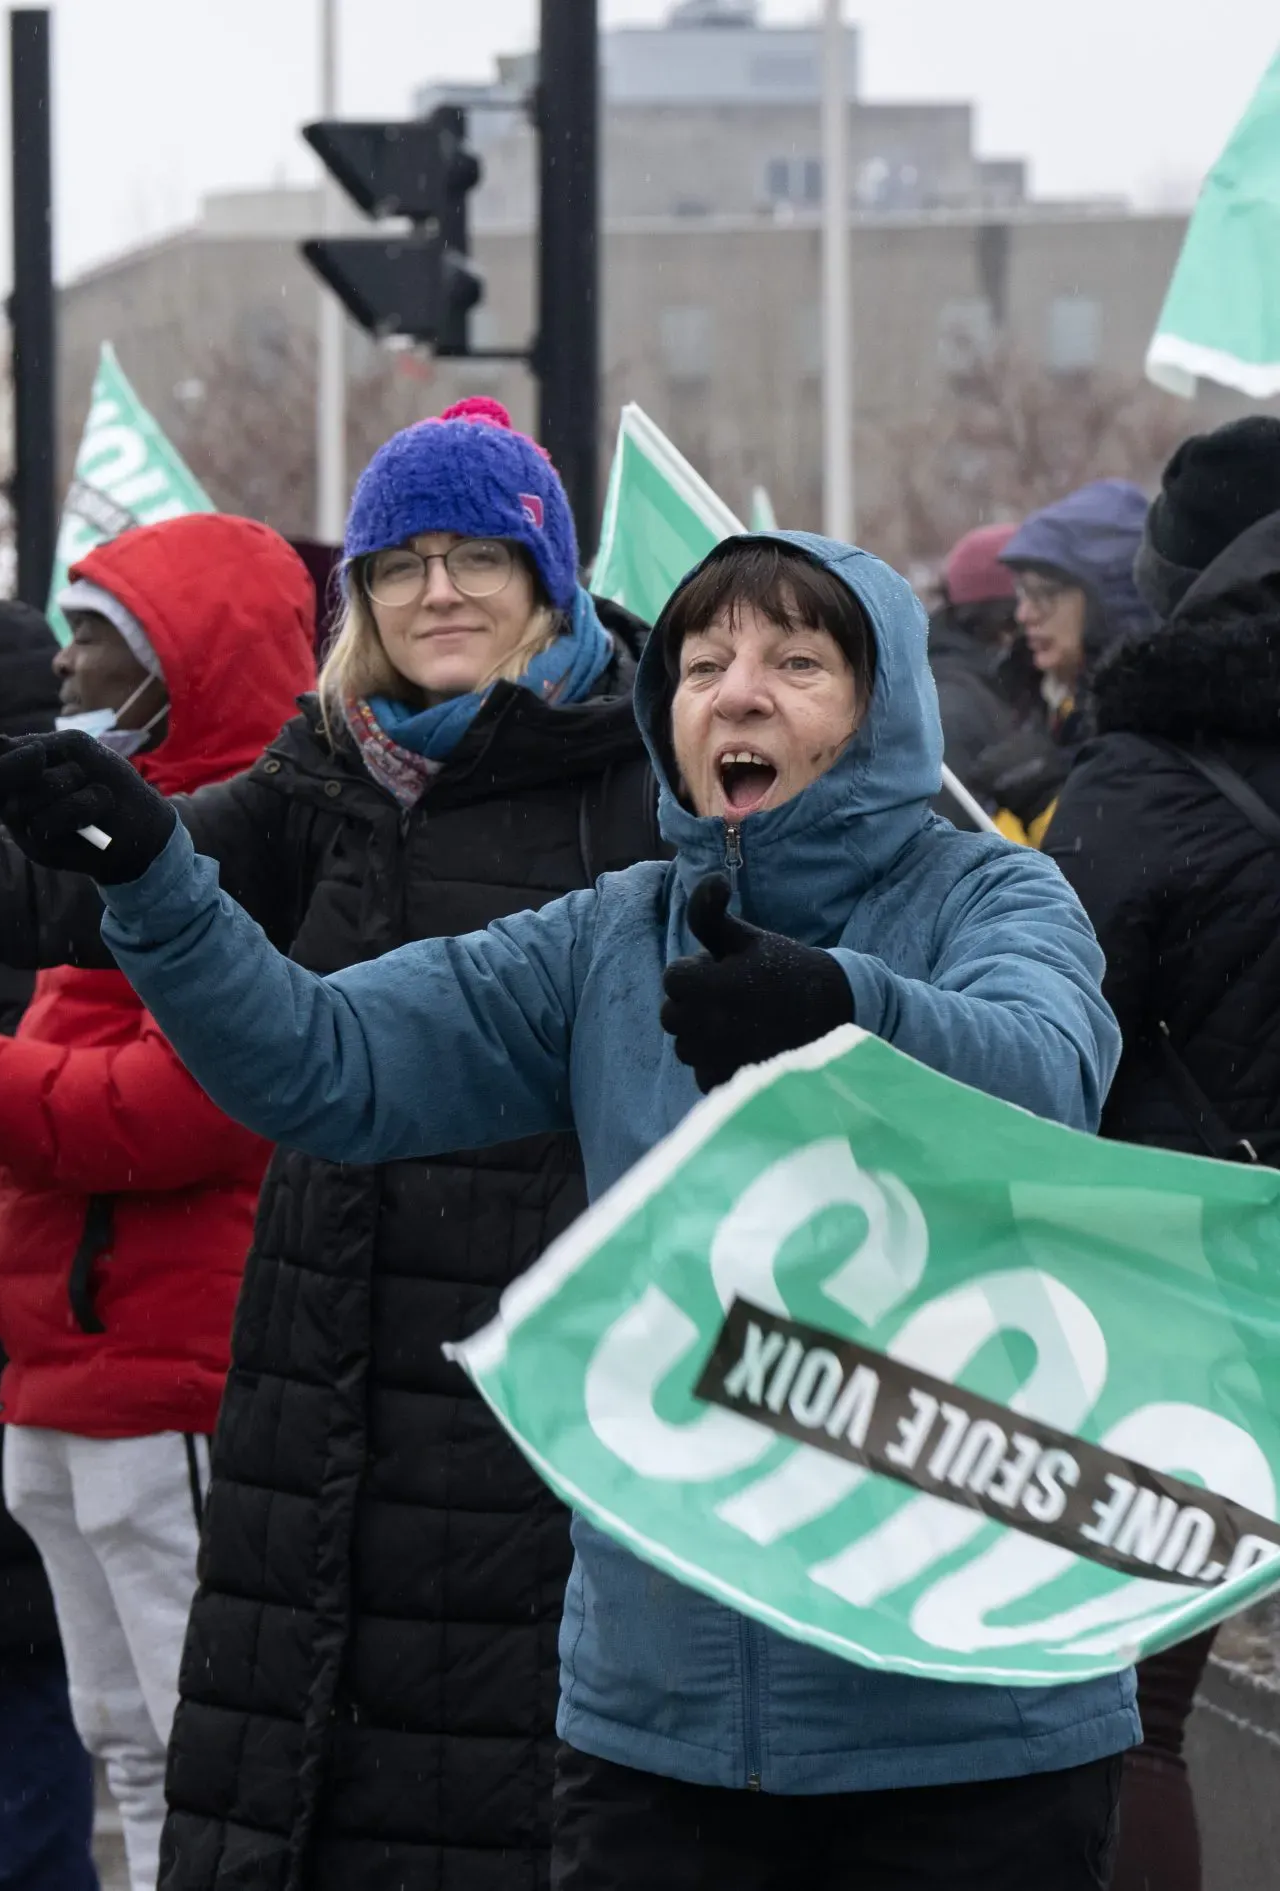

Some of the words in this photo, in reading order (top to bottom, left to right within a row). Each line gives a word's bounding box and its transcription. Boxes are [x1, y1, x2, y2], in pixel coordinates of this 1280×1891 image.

[723, 1320, 881, 1449] VOIX
[884, 1386, 1081, 1523] SEULE
[1079, 1472, 1280, 1581] D'UNE
